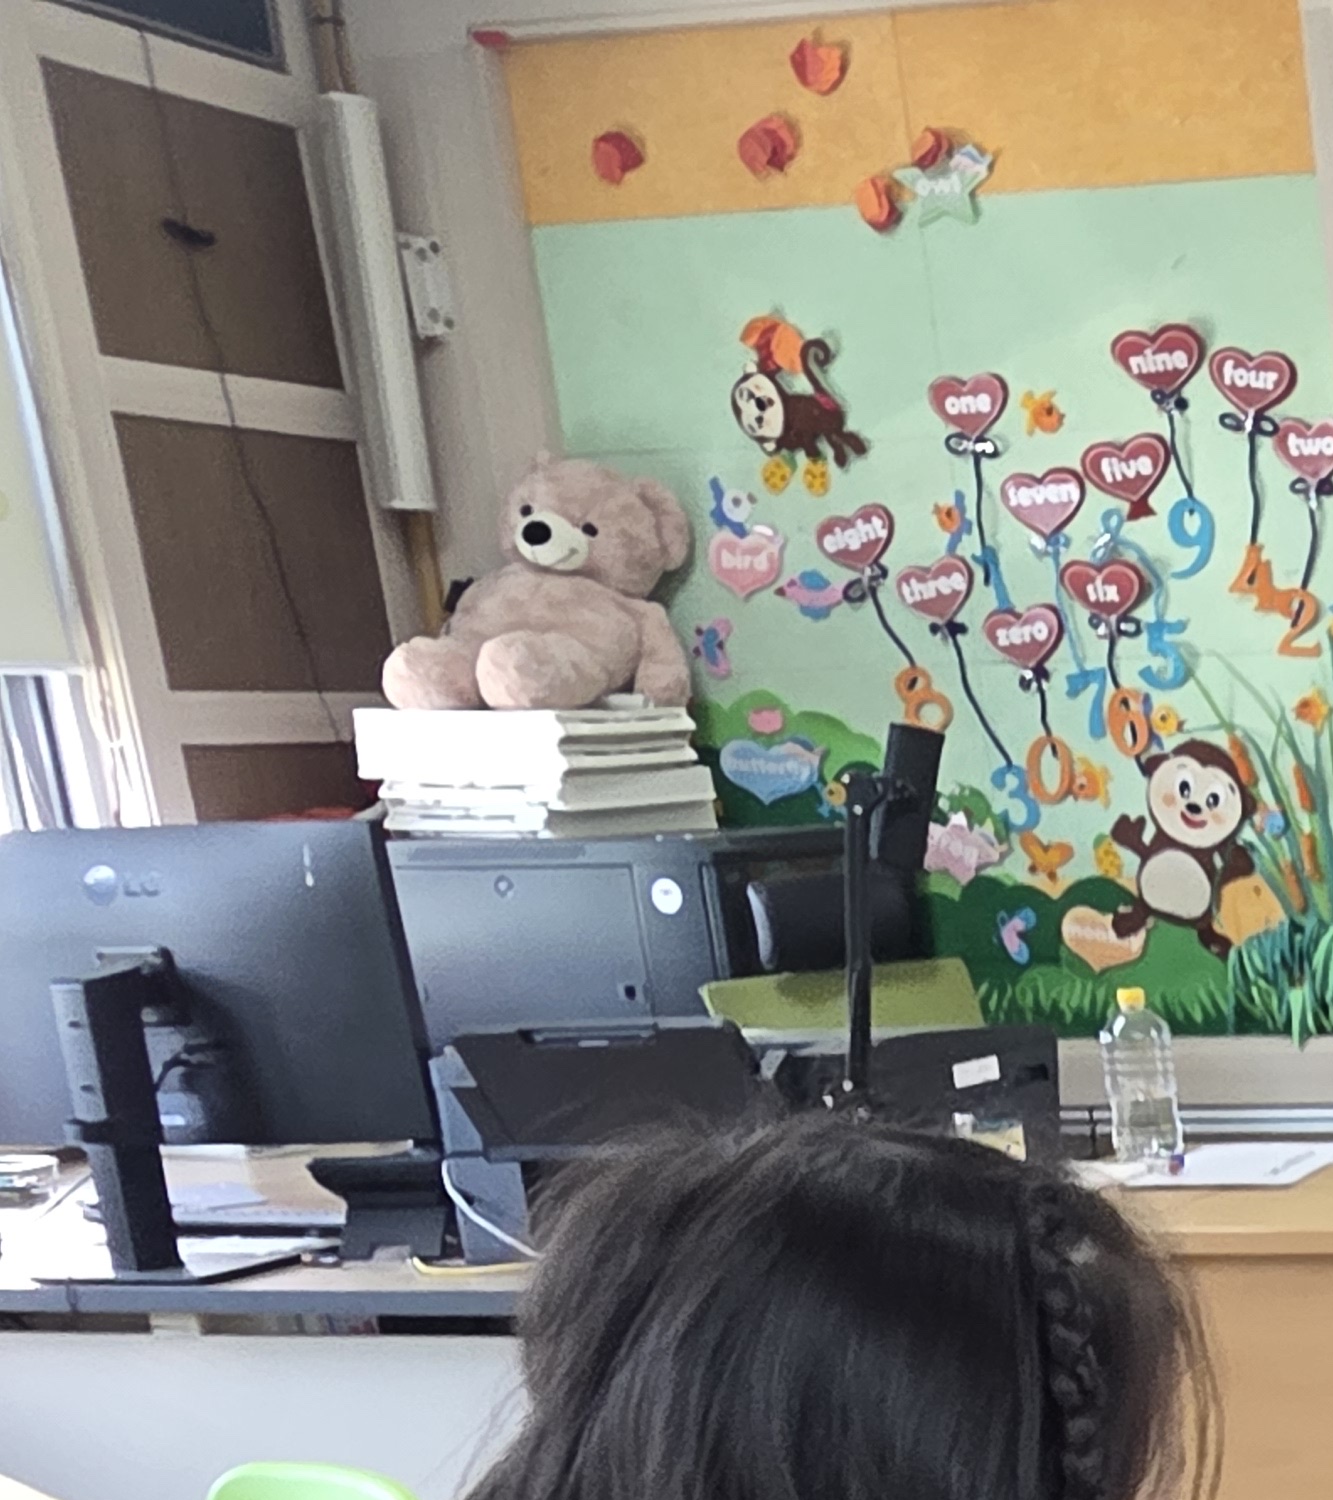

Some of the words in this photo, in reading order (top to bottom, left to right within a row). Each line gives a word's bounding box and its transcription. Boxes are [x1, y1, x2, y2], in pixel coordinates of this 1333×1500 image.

[1128, 348, 1189, 376] nine
[1223, 359, 1279, 390] four
[945, 393, 991, 415] one
[1101, 454, 1153, 483] five
[1007, 482, 1080, 507] seven
[823, 516, 887, 553] eight
[1168, 498, 1216, 579] 9
[720, 549, 769, 571] bird
[902, 572, 966, 604] three
[1086, 575, 1120, 602] six
[996, 621, 1049, 647] zero
[1140, 617, 1190, 690] 5
[1066, 667, 1108, 739] 7
[1027, 735, 1074, 805] 0
[991, 765, 1040, 833] 3
